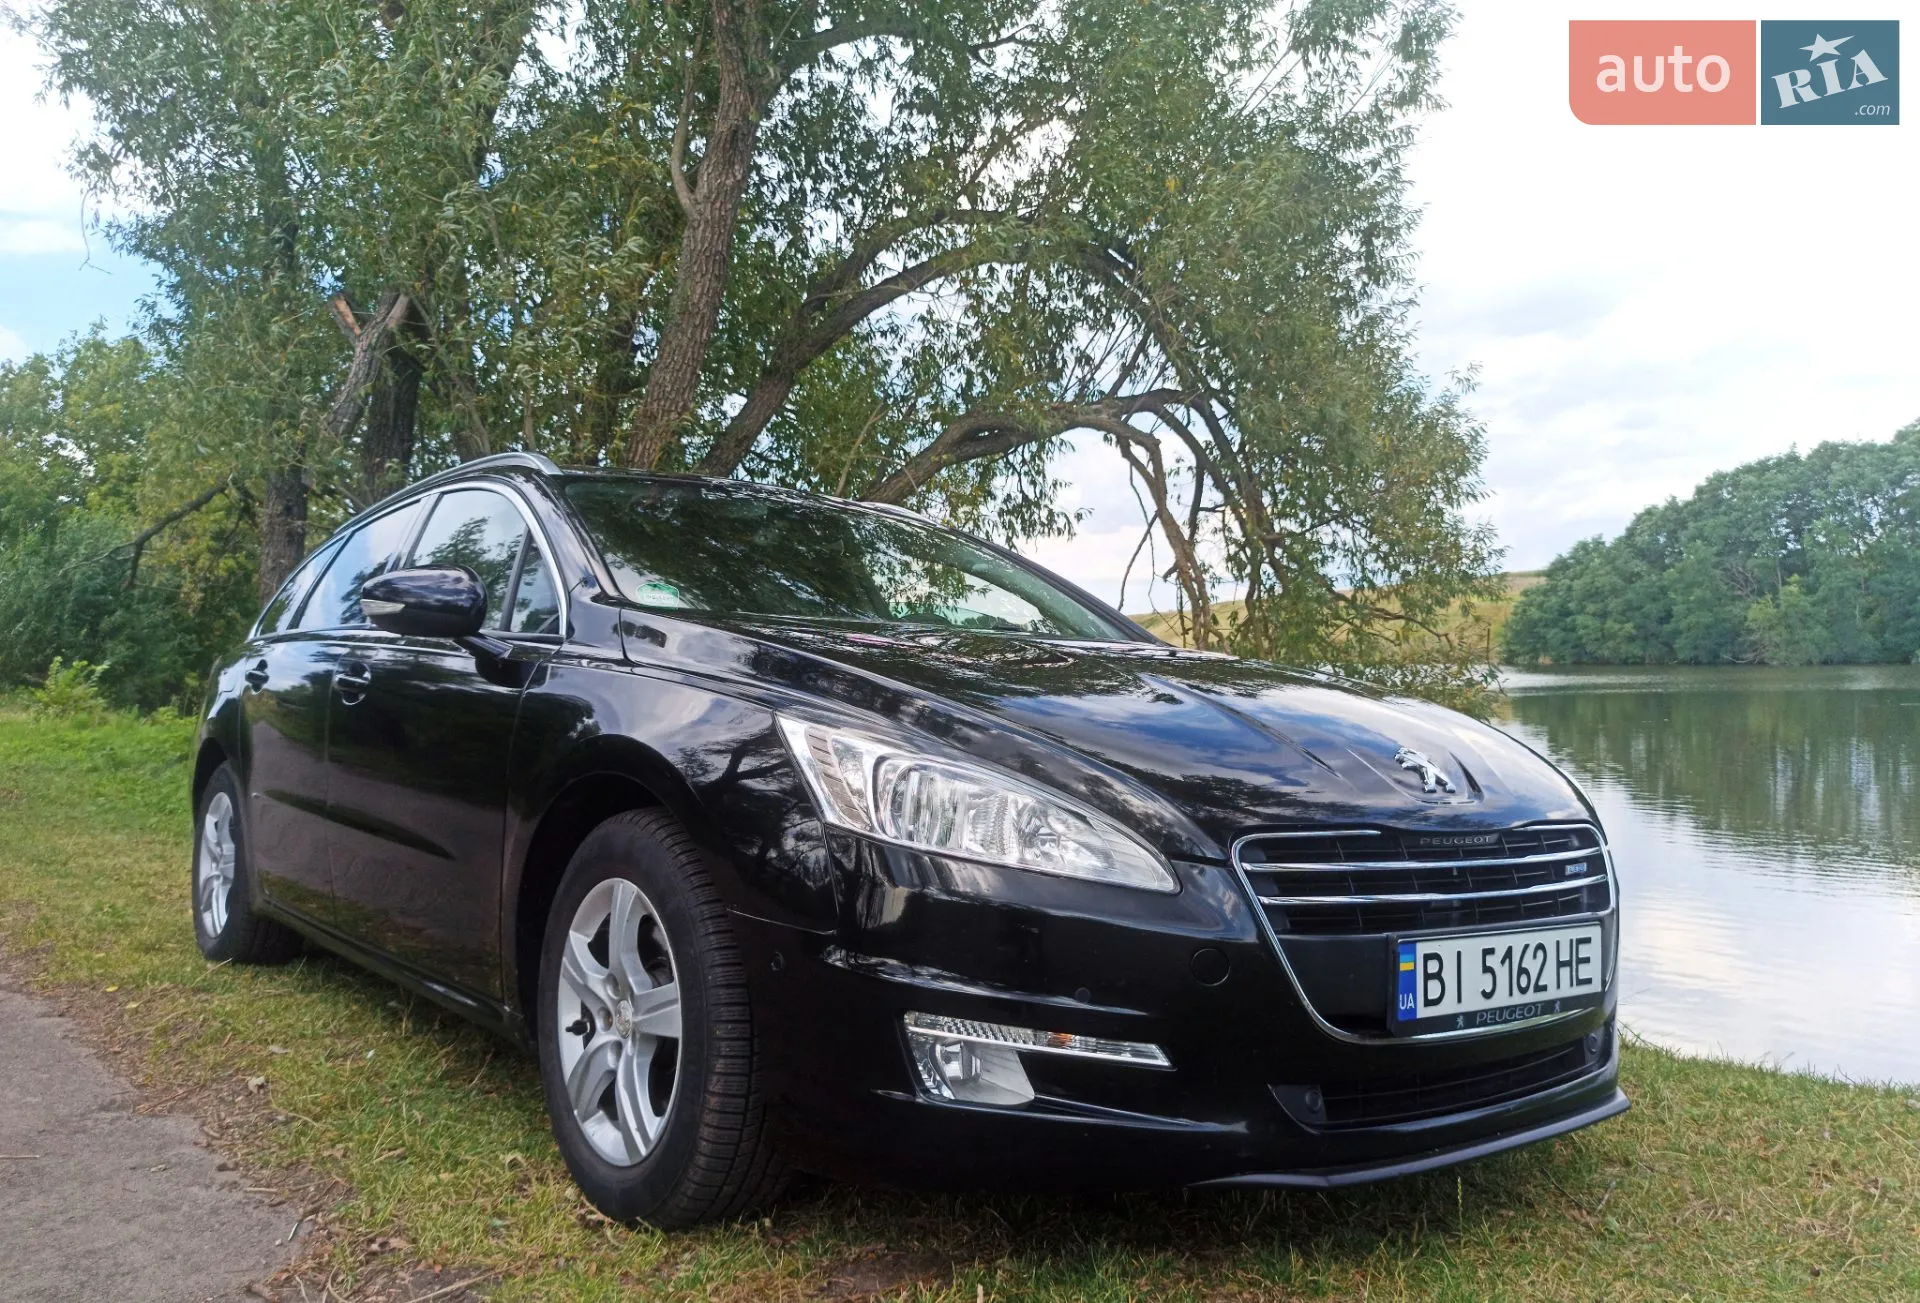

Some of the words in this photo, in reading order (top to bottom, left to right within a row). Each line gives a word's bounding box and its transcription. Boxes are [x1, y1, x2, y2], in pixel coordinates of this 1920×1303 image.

[1420, 835, 1491, 845] PEUGEOT
[1423, 952, 1462, 1007] BI
[1481, 942, 1548, 1000] 5162
[1556, 936, 1593, 990] HE
[1400, 993, 1415, 1010] UA
[1476, 1003, 1543, 1025] PEUGEOT
